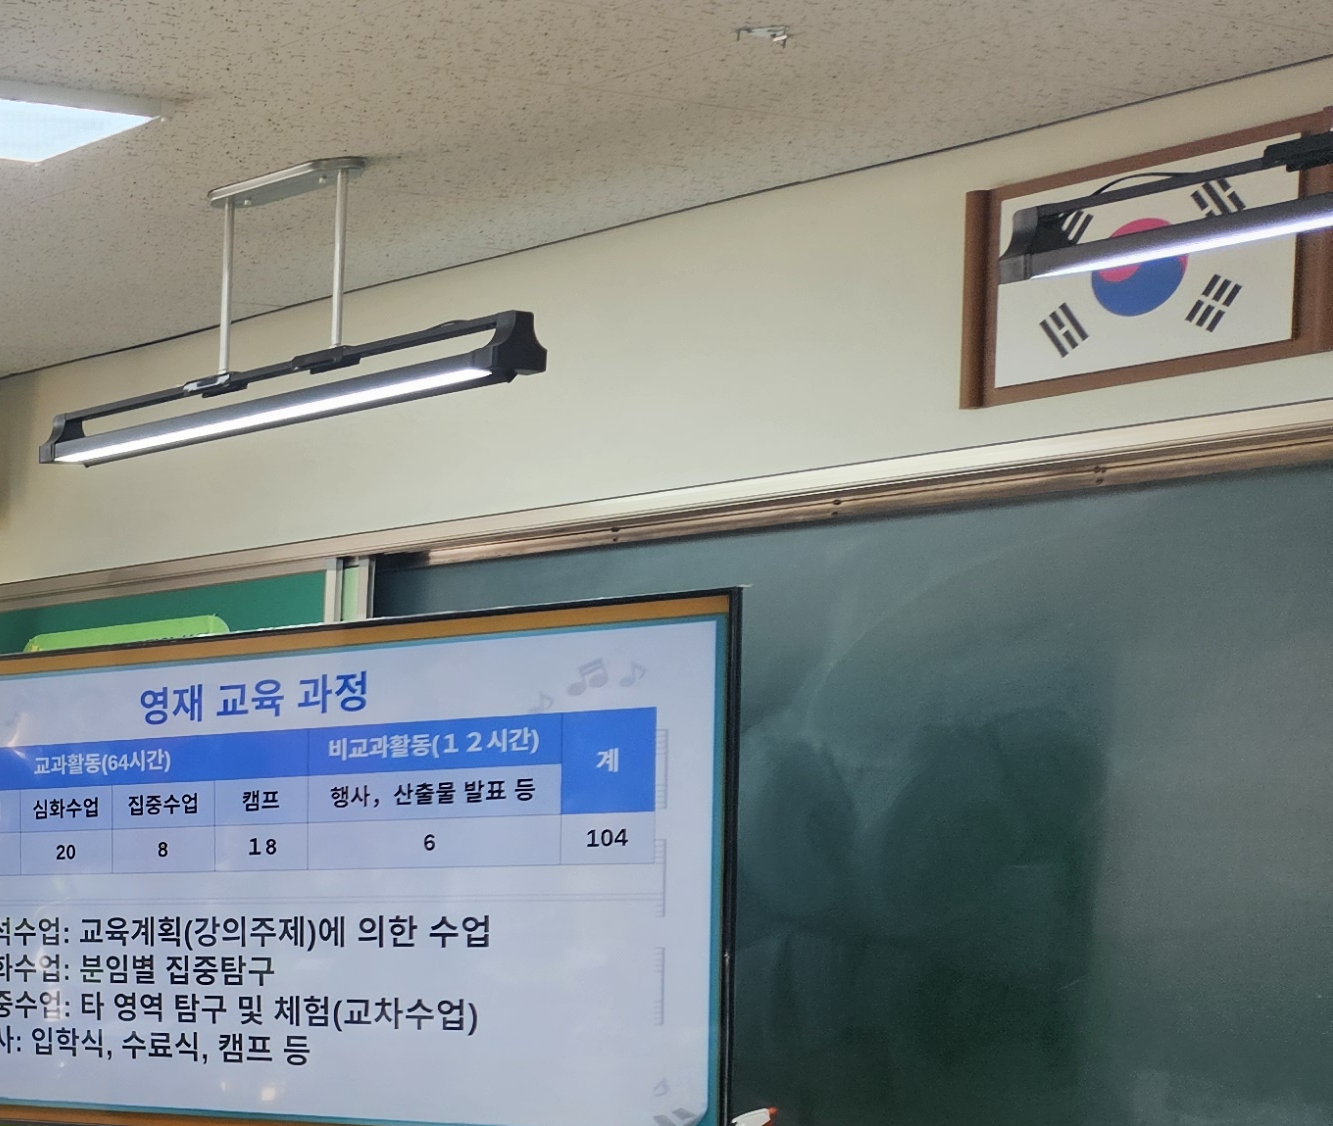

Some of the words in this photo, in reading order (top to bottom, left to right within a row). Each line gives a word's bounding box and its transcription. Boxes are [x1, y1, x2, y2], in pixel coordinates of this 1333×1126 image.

[139, 683, 204, 725] 영재
[215, 679, 284, 718] 교육
[297, 670, 368, 714] 과정
[33, 749, 172, 776] 교과활동(64시간)
[596, 748, 619, 773] 계
[127, 792, 199, 816] 집중수업
[242, 790, 280, 812] 캠프
[330, 785, 380, 808] 행사,
[394, 781, 456, 806] 산출물
[464, 779, 507, 804] 발표
[514, 778, 536, 801] 등
[33, 797, 100, 820] 심화수업
[157, 842, 168, 857] 8
[249, 838, 277, 855] 18
[423, 834, 436, 851] 6
[586, 828, 629, 848] 104
[56, 844, 76, 860] 20
[79, 916, 345, 951] 교육계획(강의주제)에
[357, 915, 418, 948] 의한
[429, 915, 491, 948] 수업
[79, 954, 156, 985] 분임별
[166, 955, 275, 986] 집중탐구
[81, 991, 105, 1021] 타
[113, 992, 163, 1023] 영역
[175, 993, 227, 1024] 탐구
[238, 994, 263, 1025] 및
[274, 995, 478, 1036] 체험(교차수업)
[32, 1027, 113, 1060] 입학식,
[122, 1031, 208, 1064] 수료식,
[218, 1033, 273, 1063] 캠프
[283, 1034, 311, 1066] 등
